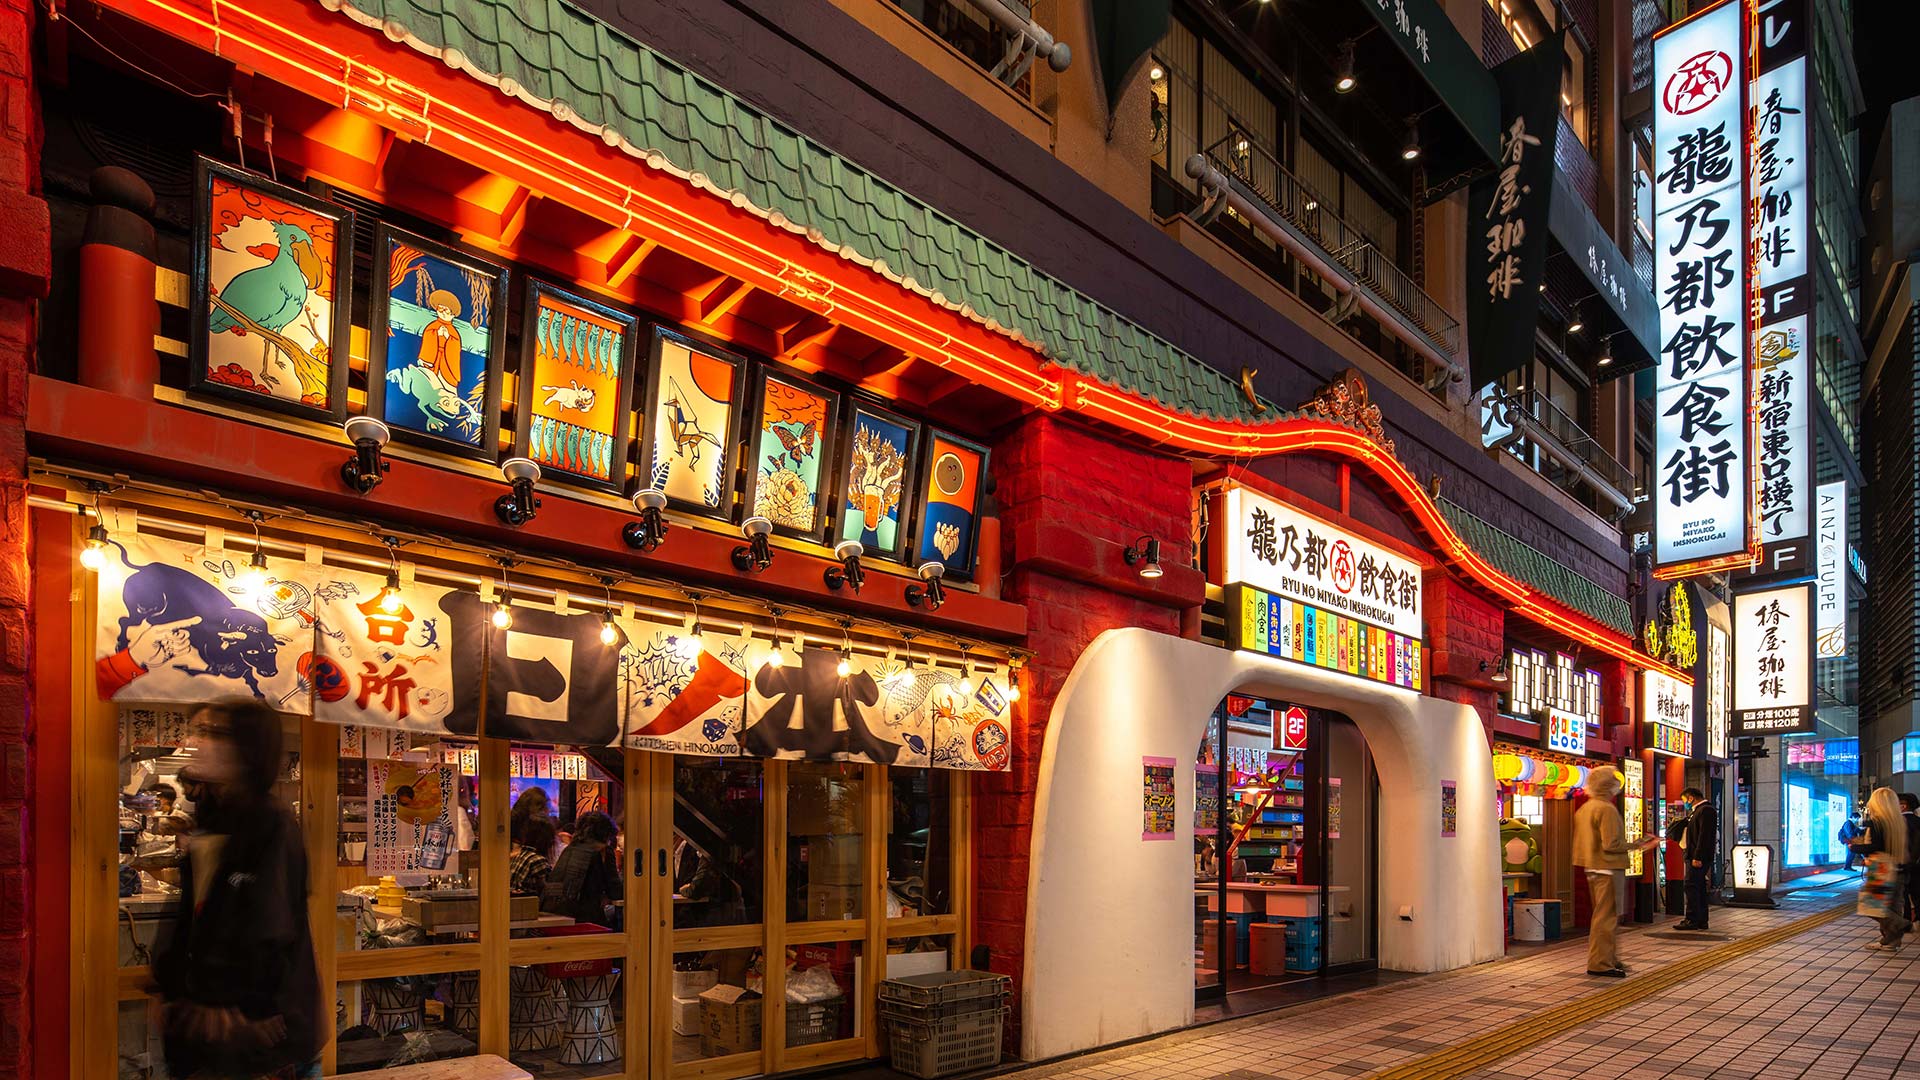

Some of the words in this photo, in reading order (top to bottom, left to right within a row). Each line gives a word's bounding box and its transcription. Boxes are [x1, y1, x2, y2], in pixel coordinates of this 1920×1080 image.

[1656, 119, 1739, 508] 龍乃都飲食街
[1759, 369, 1795, 537] 新宿東口横丁
[1672, 531, 1727, 547] INSHOKUGAI
[1682, 520, 1700, 529] RYU
[1701, 517, 1715, 526] NO
[1682, 525, 1715, 537] MIYAKO
[1820, 494, 1836, 543] AINZ
[1246, 506, 1328, 581] 龍乃都
[1357, 551, 1418, 615] 飲食街
[1281, 575, 1300, 595] RYU
[1302, 582, 1316, 599] NO
[1316, 588, 1348, 610] MIYAKO
[1349, 599, 1395, 625] INSHOKUGAI
[1820, 560, 1836, 612] TULPE
[355, 586, 421, 722] 台所
[1754, 598, 1790, 699] 椿屋珈琲
[632, 735, 682, 752] KITCHEN
[684, 742, 738, 755] HINOMOTO
[1288, 717, 1304, 735] 2F
[564, 960, 594, 973] Coca-Cola
